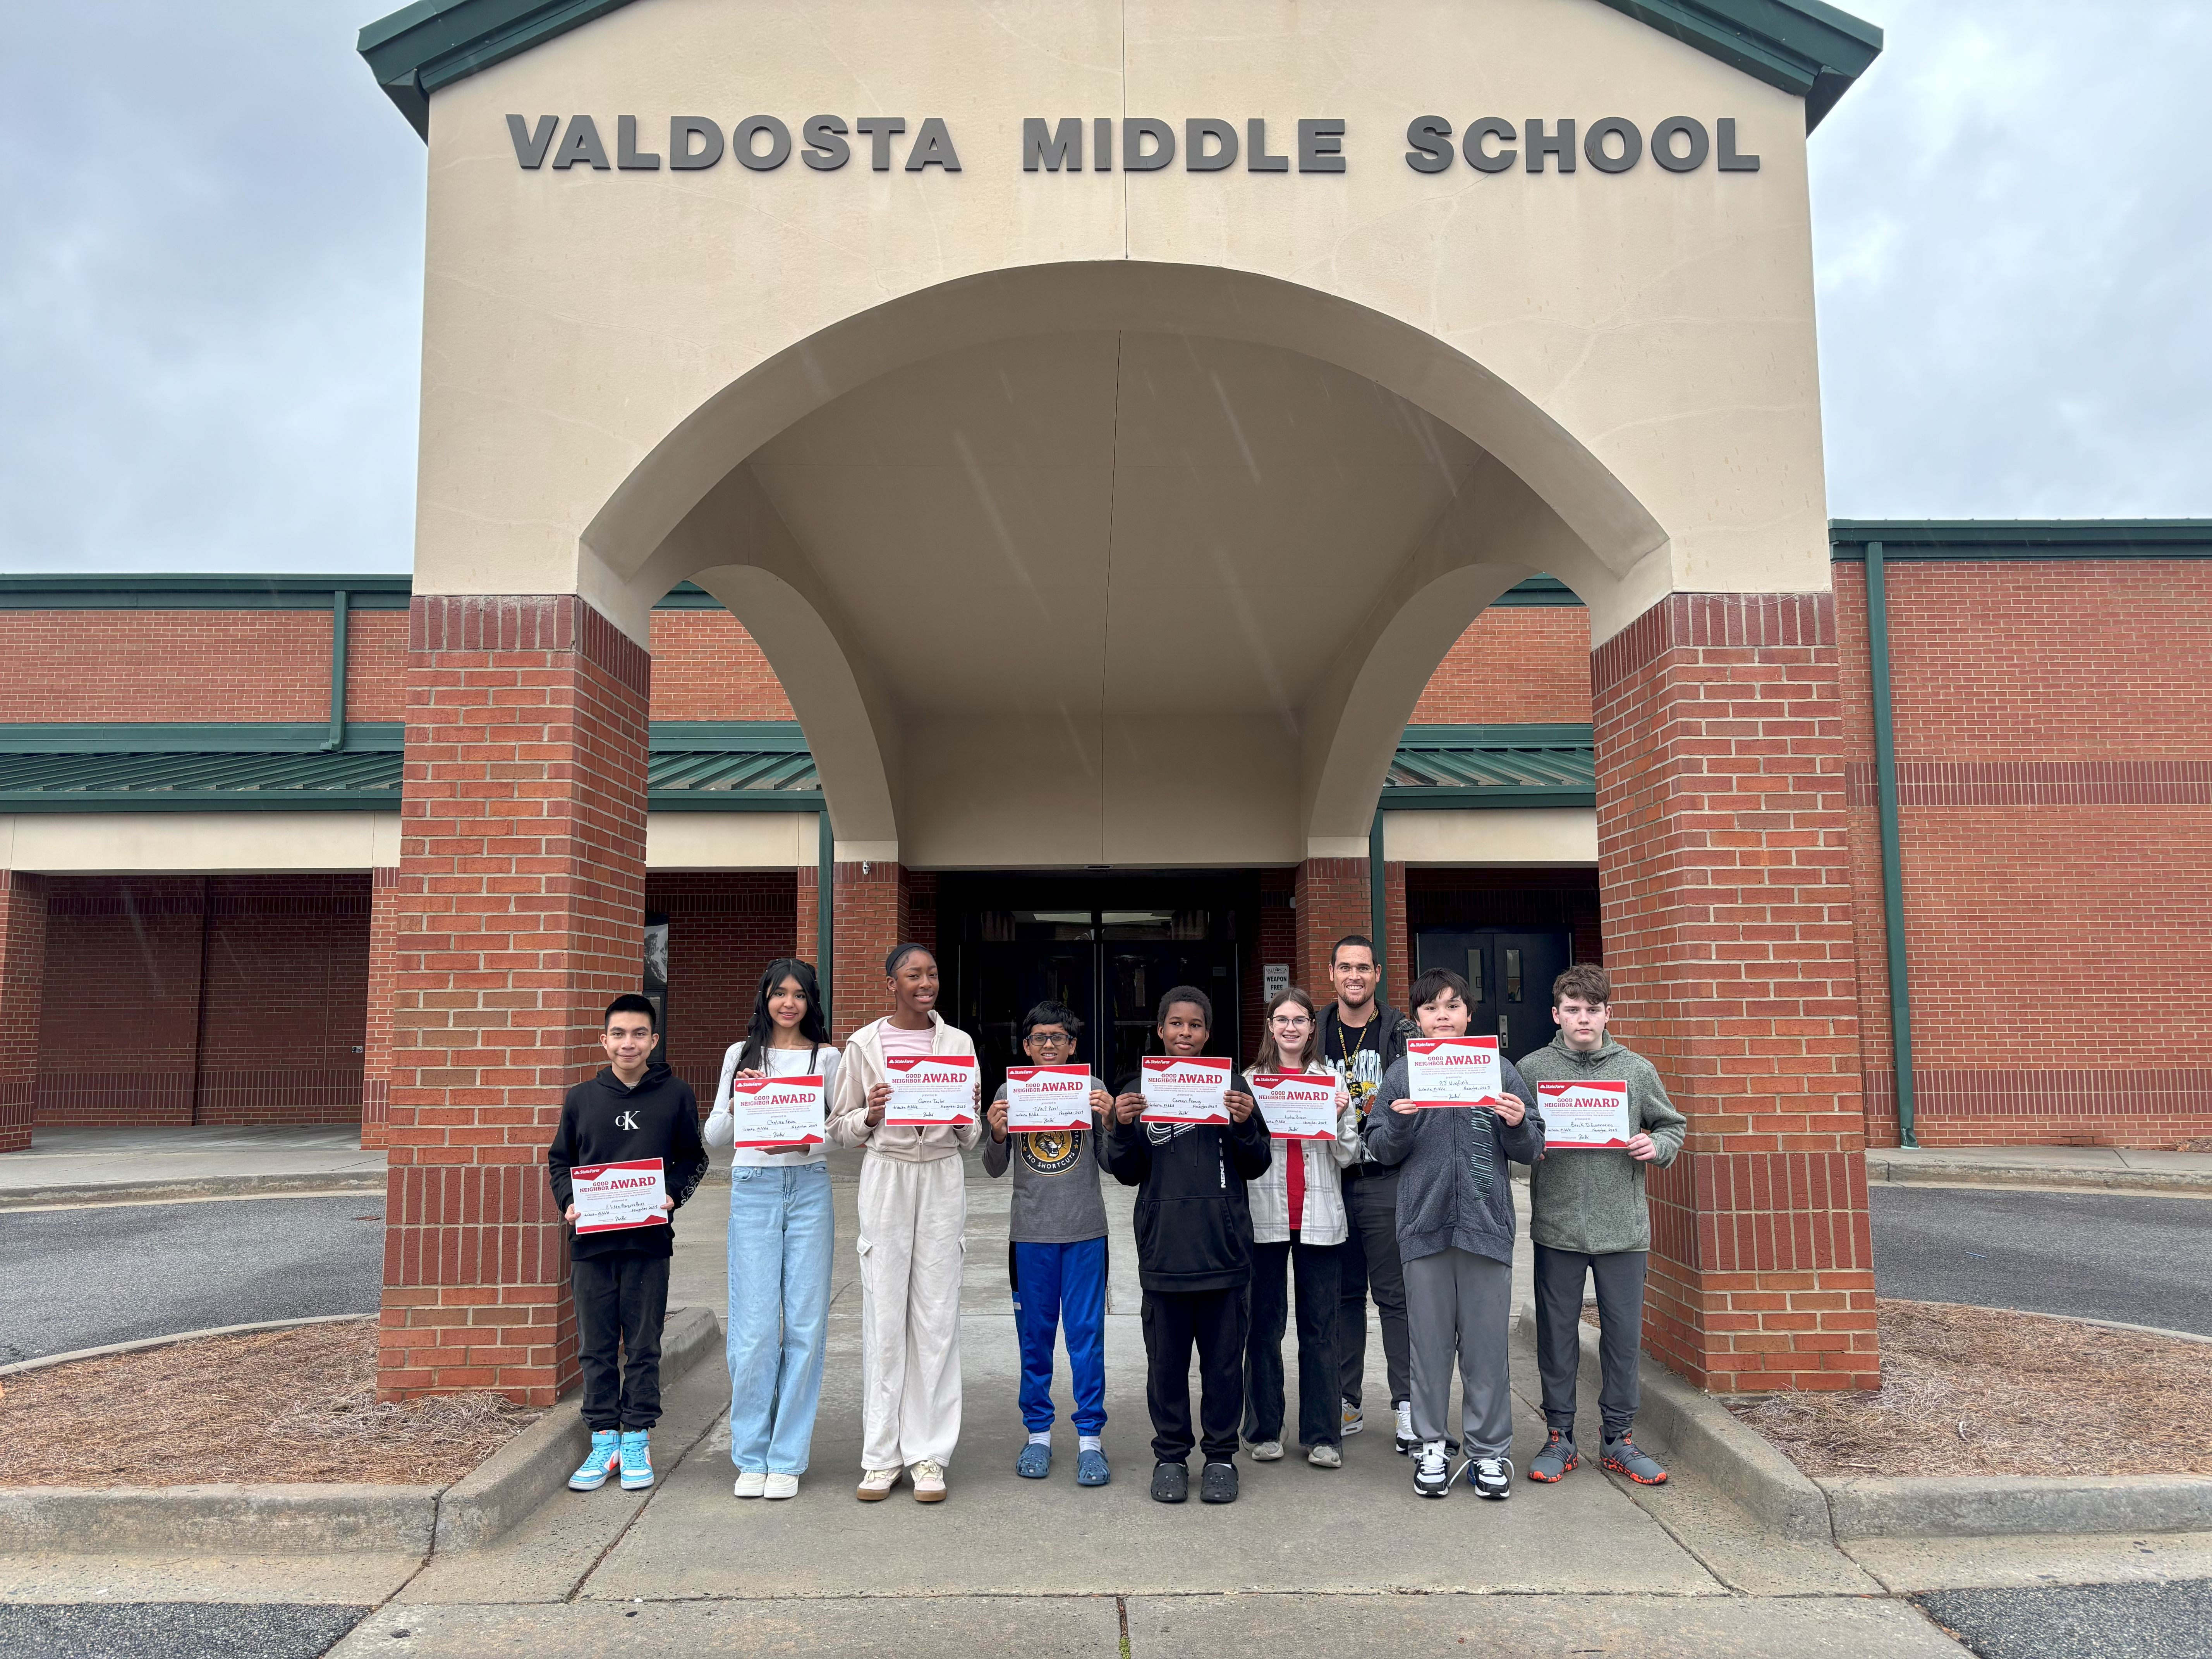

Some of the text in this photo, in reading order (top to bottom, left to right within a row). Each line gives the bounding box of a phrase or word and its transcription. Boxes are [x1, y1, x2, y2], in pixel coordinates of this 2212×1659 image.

[506, 114, 1760, 175] VALDOSTA MIDDLE SCHOOL
[1445, 1054, 1491, 1065] AWARD
[922, 1073, 967, 1083] AWARD
[1177, 1073, 1223, 1084] AWARD
[1041, 1081, 1083, 1092] AWARD
[770, 1093, 816, 1104] AWARD
[1286, 1091, 1329, 1101] AWARD
[1574, 1098, 1619, 1107] AWARD
[1027, 1152, 1075, 1169] NO SHORTCUTS
[610, 1176, 656, 1190] AWARD
